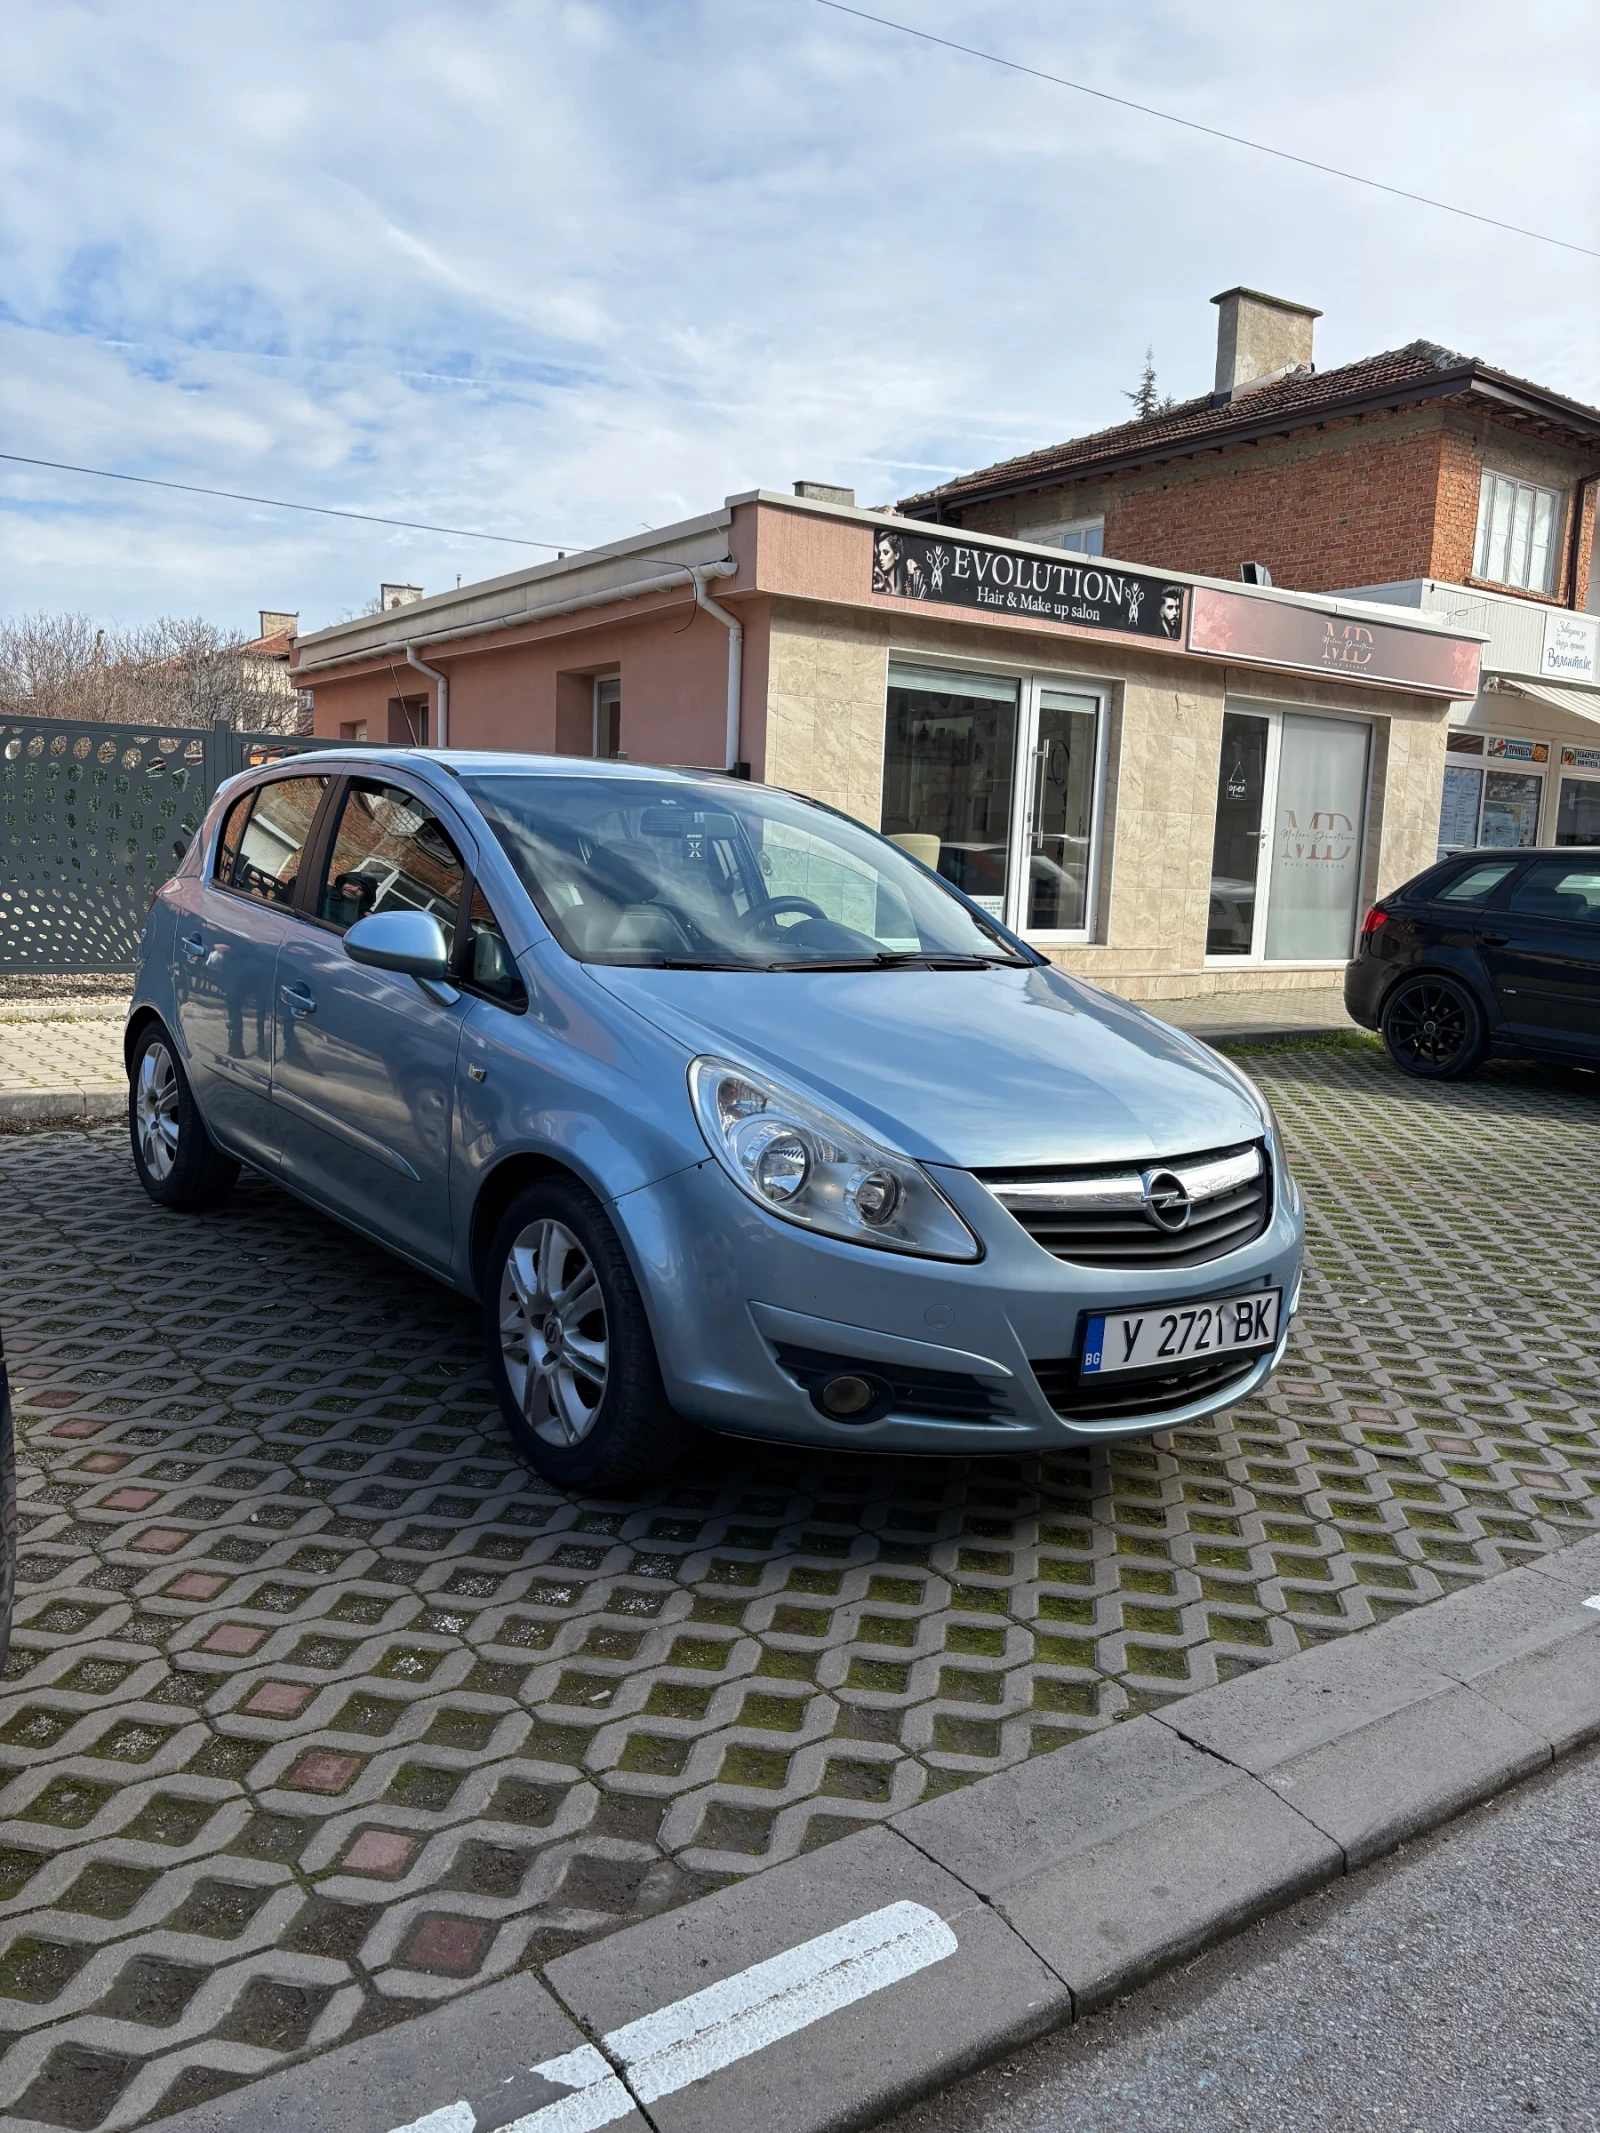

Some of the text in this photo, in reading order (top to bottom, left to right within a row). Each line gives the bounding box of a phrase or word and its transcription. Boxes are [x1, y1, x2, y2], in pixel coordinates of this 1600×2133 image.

[951, 546, 1125, 606] EVOLUTION
[977, 586, 1100, 621] Hair & Make up salon
[1321, 621, 1374, 664] MD
[1228, 784, 1245, 795] open
[1281, 809, 1353, 861] MD
[1157, 1305, 1225, 1358] 2721
[1085, 1352, 1100, 1366] BG
